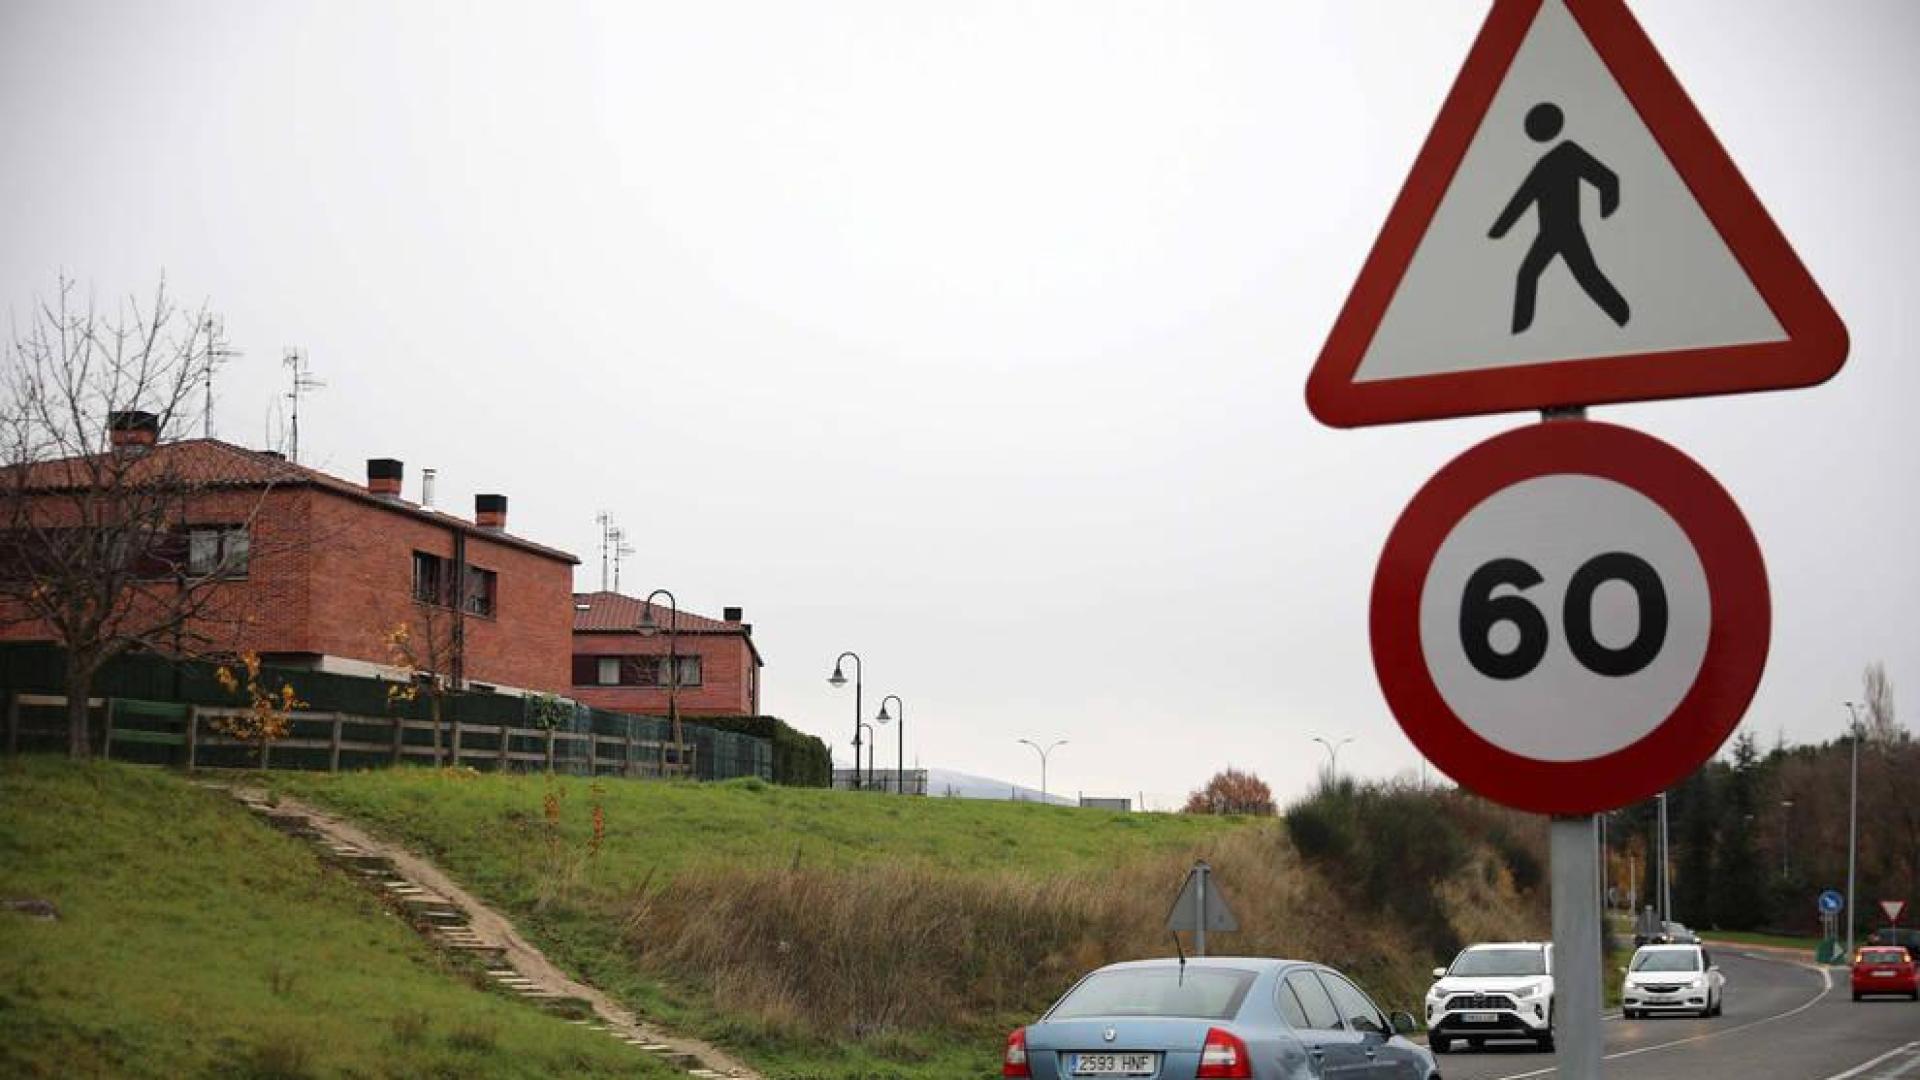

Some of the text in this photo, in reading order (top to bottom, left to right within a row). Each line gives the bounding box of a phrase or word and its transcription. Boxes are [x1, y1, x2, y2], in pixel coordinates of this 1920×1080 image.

[1460, 551, 1668, 680] 60
[1079, 1055, 1150, 1071] 2593 HNF
